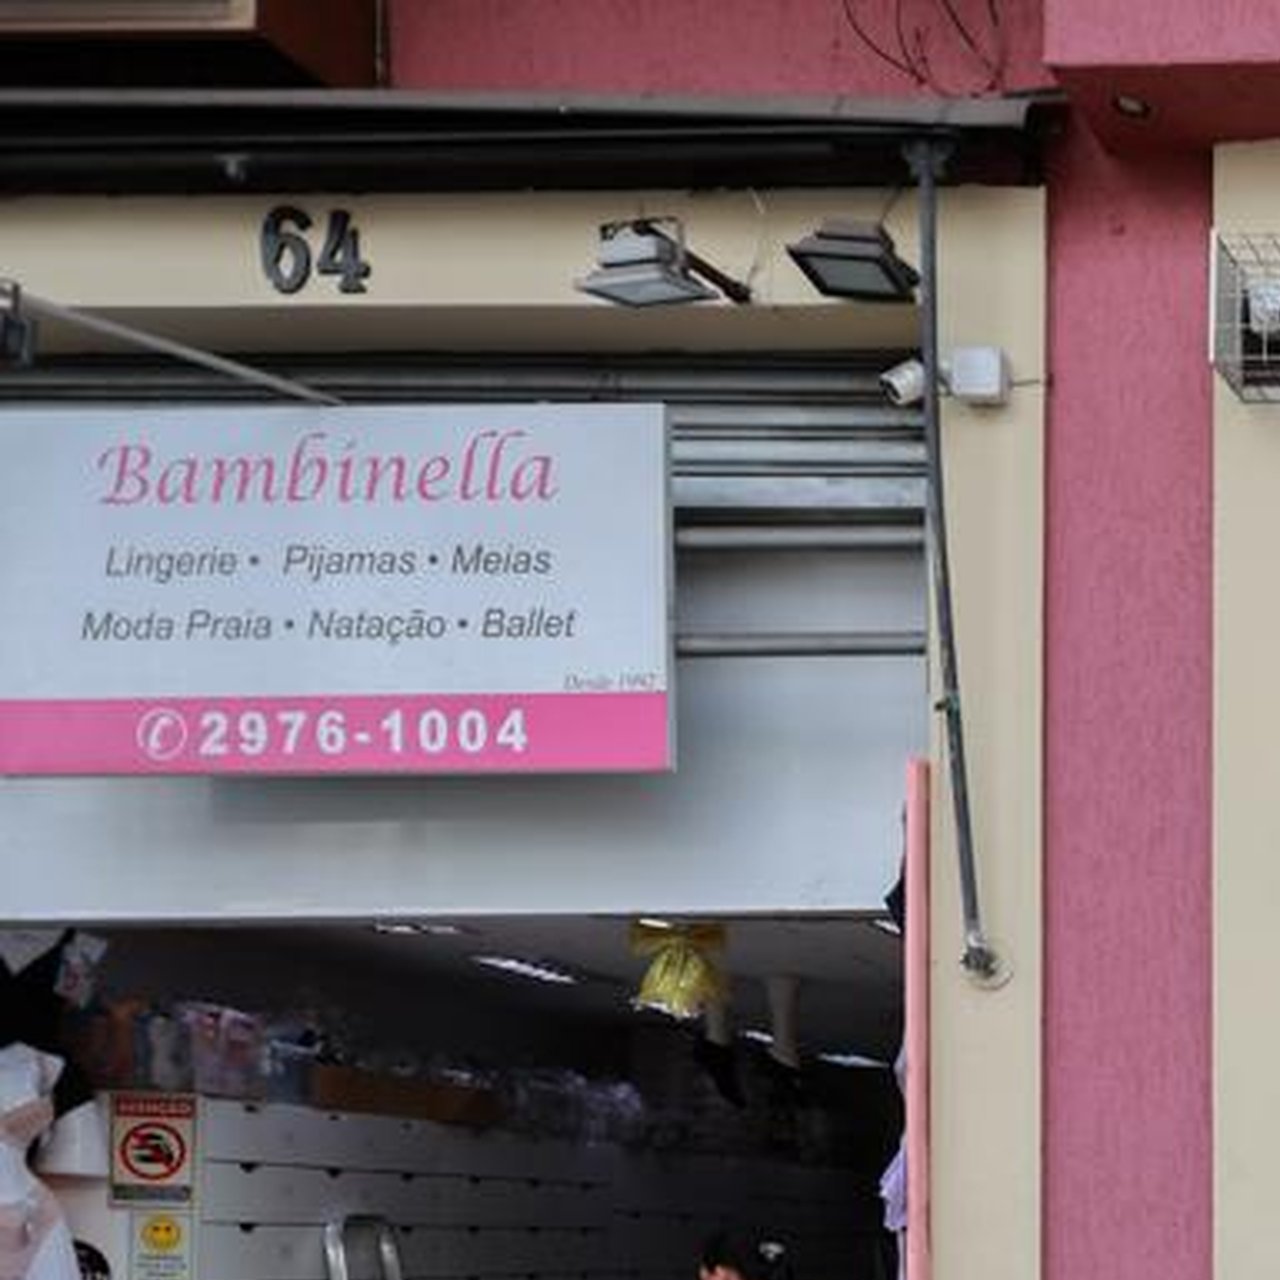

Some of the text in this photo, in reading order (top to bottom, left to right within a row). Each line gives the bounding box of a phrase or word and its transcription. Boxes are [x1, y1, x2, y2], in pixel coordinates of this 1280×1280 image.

[262, 206, 371, 294] 64
[98, 430, 559, 506] Bambinella
[105, 544, 551, 583] Lingerie Pijamas Meias
[82, 608, 577, 648] Moda Praia Natação Ballet
[200, 708, 528, 757] 2976-1004
